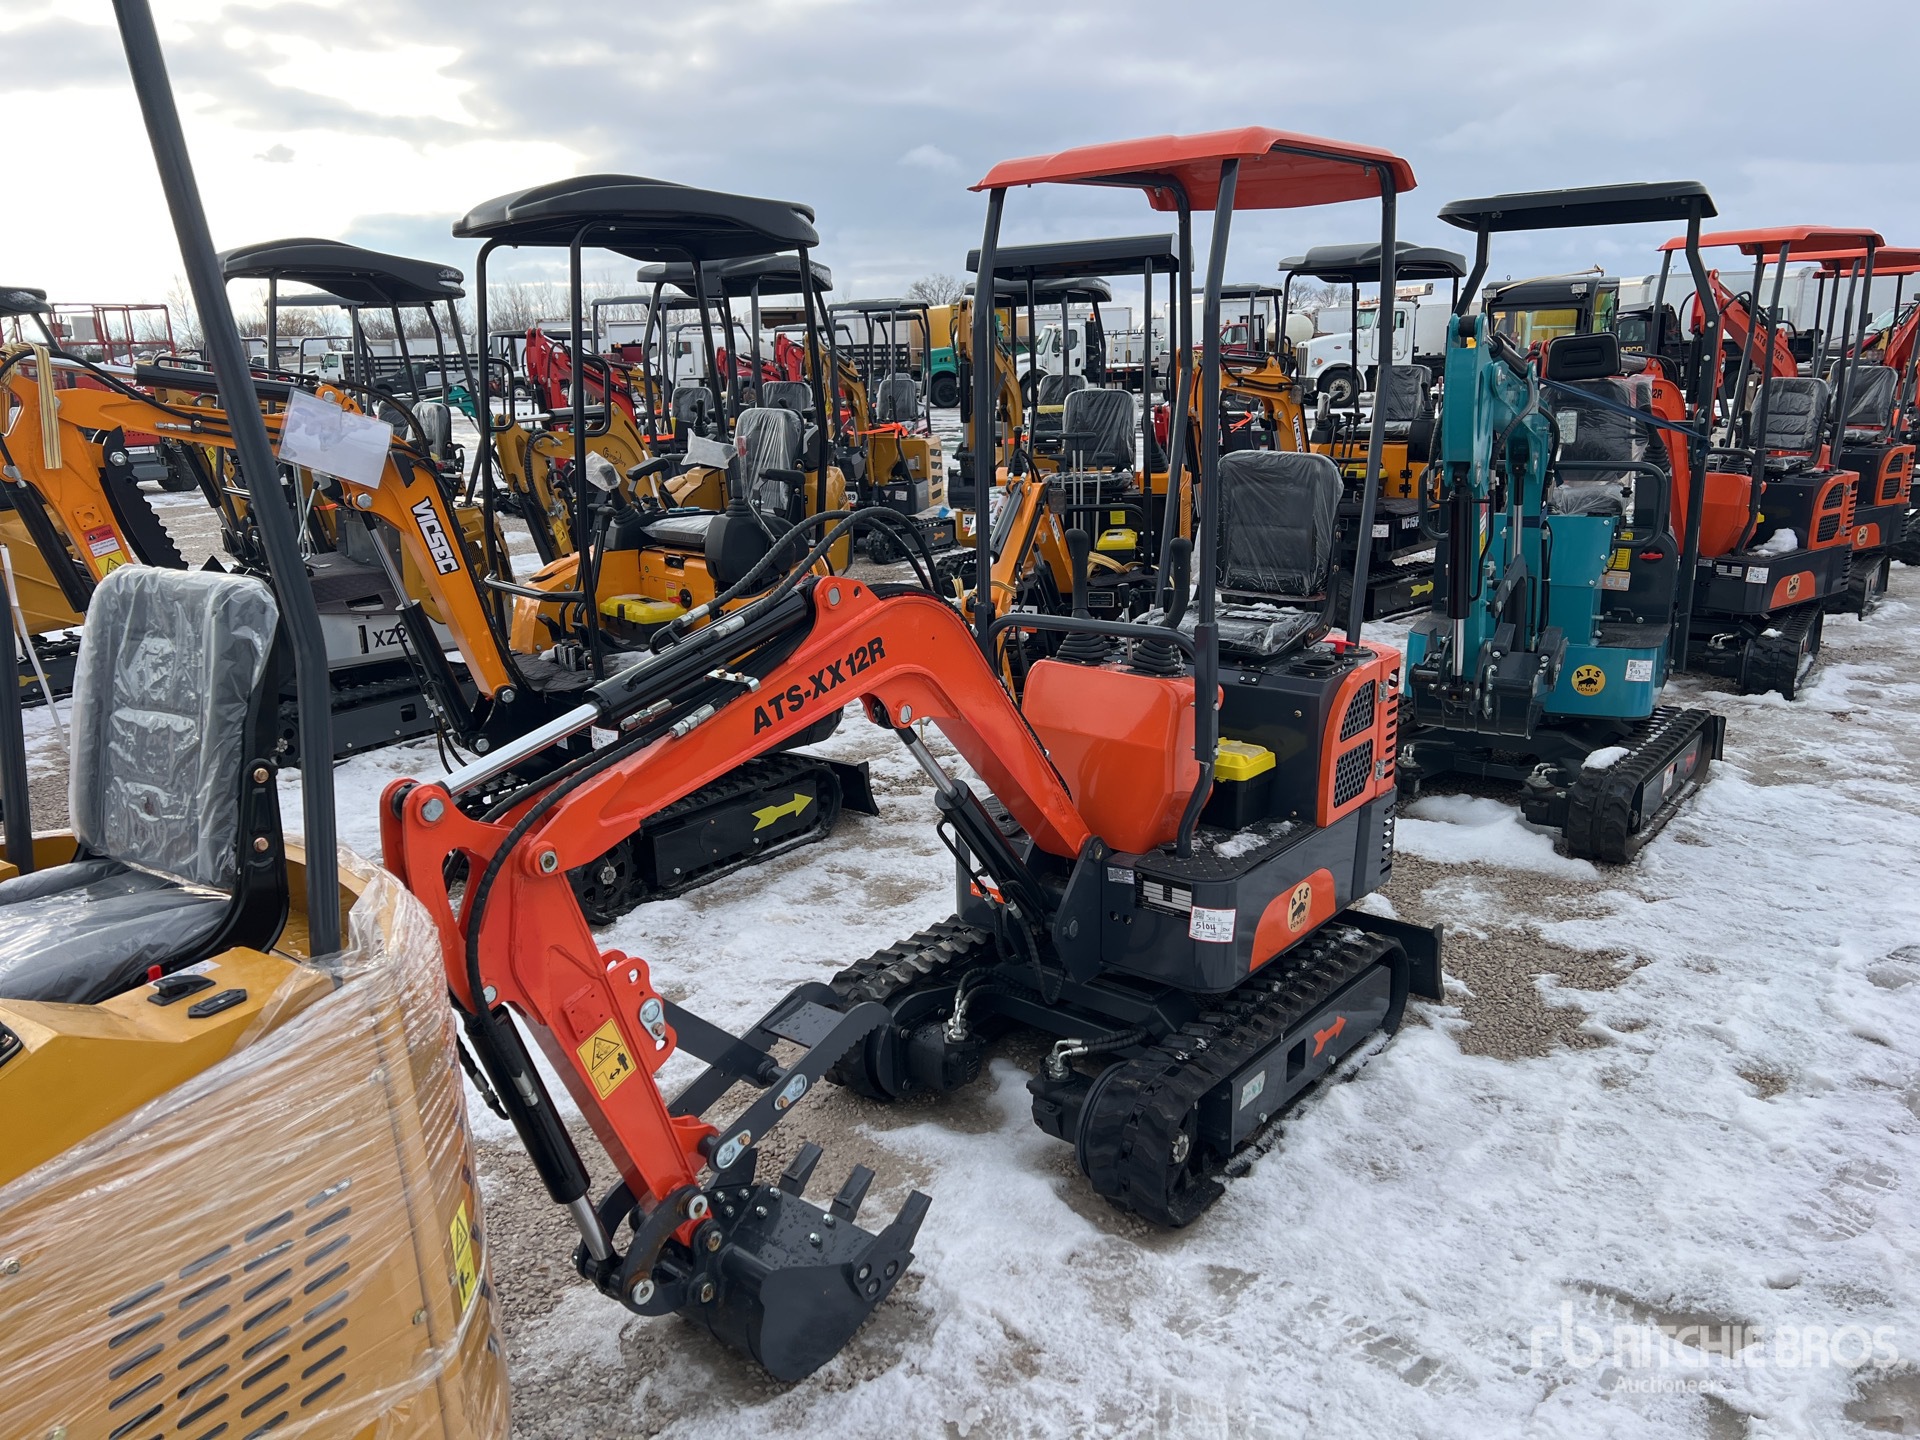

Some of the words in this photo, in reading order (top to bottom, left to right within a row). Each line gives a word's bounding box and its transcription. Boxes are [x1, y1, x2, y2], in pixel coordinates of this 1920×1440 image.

[411, 496, 460, 576] VICSEC
[1576, 668, 1602, 679] ATS
[1291, 887, 1310, 910] ATS
[1195, 921, 1216, 934] 5104
